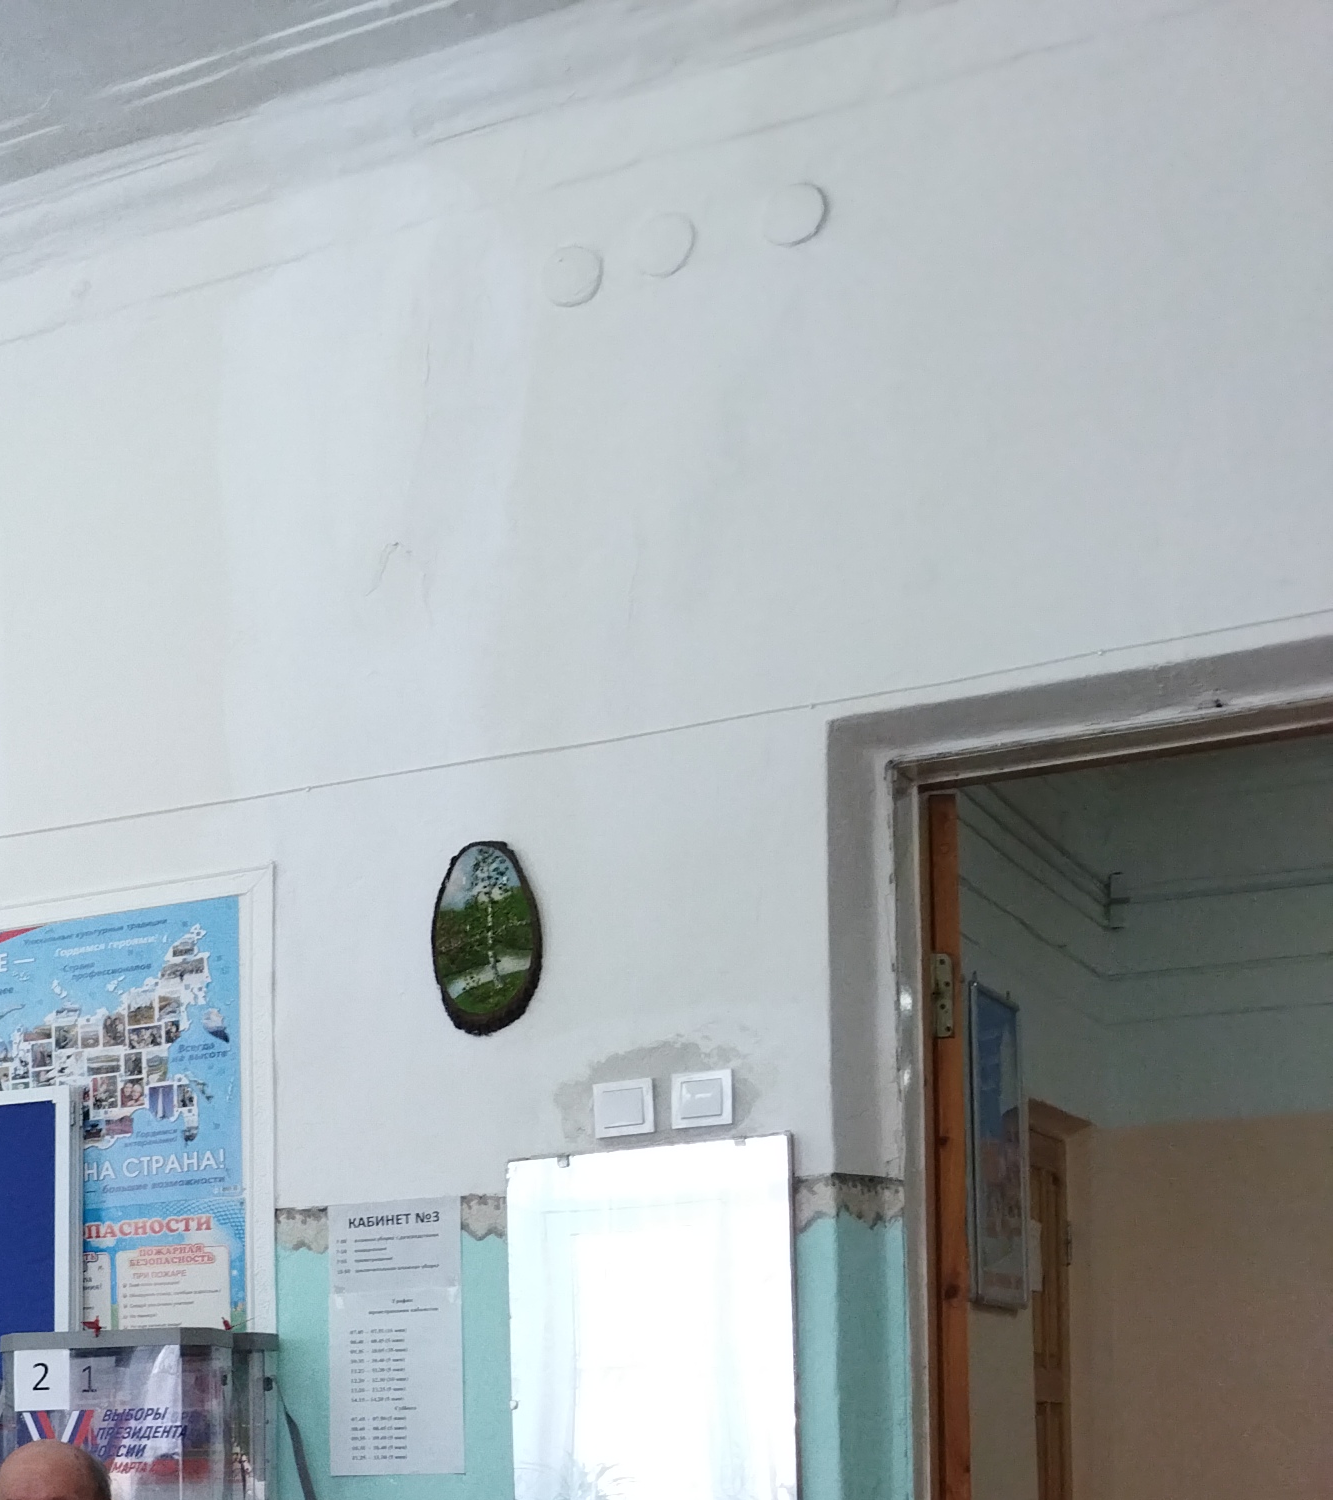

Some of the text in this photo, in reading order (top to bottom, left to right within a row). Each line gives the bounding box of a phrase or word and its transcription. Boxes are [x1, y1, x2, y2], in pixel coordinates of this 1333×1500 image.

[123, 1149, 225, 1178] СТРАНА!
[349, 1211, 440, 1229] КАБИНЕТ №3
[139, 1245, 204, 1257] ПОЖАРНАЯ
[129, 1253, 214, 1267] БЕЗОПАСНОСТЬ
[32, 1362, 50, 1391] 2
[82, 1365, 97, 1393] 1
[102, 1407, 169, 1422] ВЫБОРЫ
[96, 1425, 187, 1440] ПРЕЗИДЕНТА
[97, 1444, 147, 1458] ОССИИ
